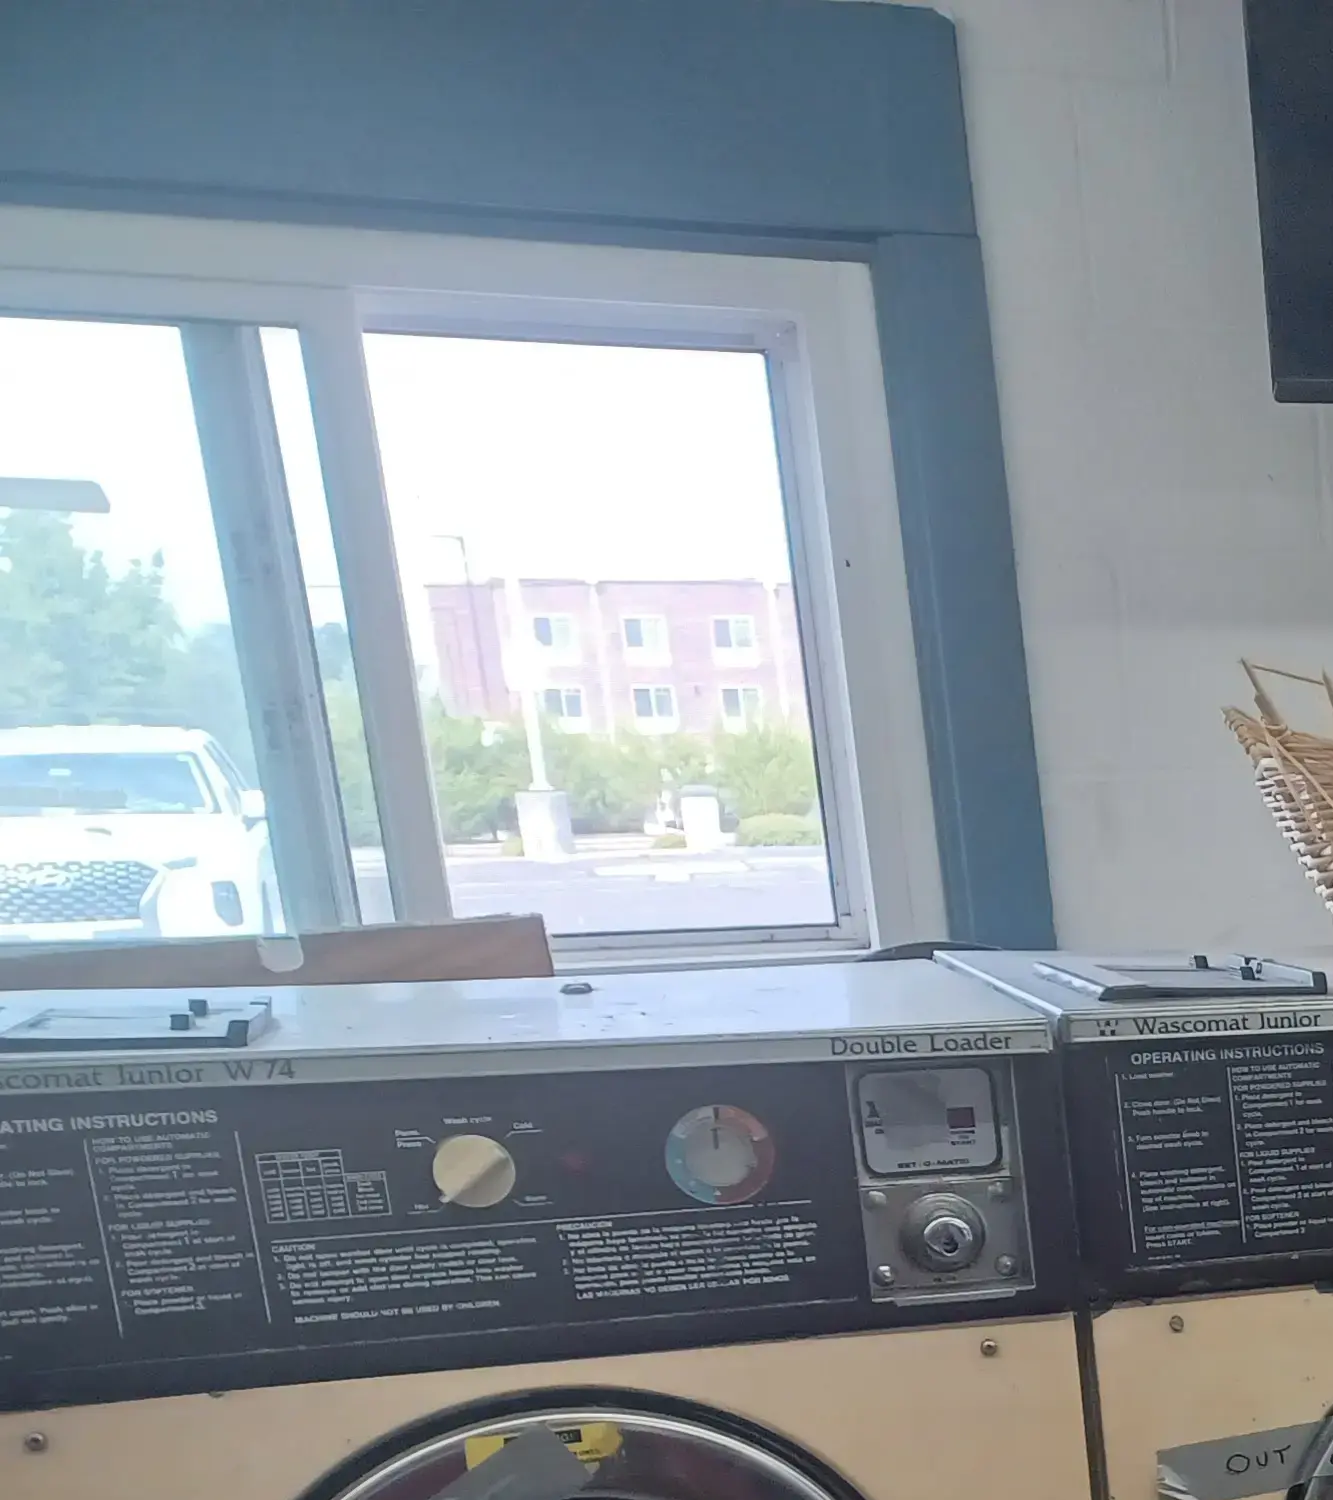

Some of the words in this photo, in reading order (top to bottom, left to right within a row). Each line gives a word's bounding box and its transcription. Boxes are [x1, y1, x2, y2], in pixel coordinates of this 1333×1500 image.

[1133, 1014, 1249, 1036] Wascomat
[1259, 1012, 1321, 1030] Junior
[831, 1034, 917, 1057] Double
[929, 1032, 1013, 1053] Loader
[1131, 1046, 1217, 1065] OPERATING
[1220, 1042, 1325, 1060] INSTRUCTIONS
[118, 1063, 204, 1086] Junior
[222, 1060, 253, 1082] W
[265, 1058, 297, 1080] 74
[70, 1109, 219, 1131] INSTRUCTIONS
[1225, 1444, 1292, 1474] OUT
